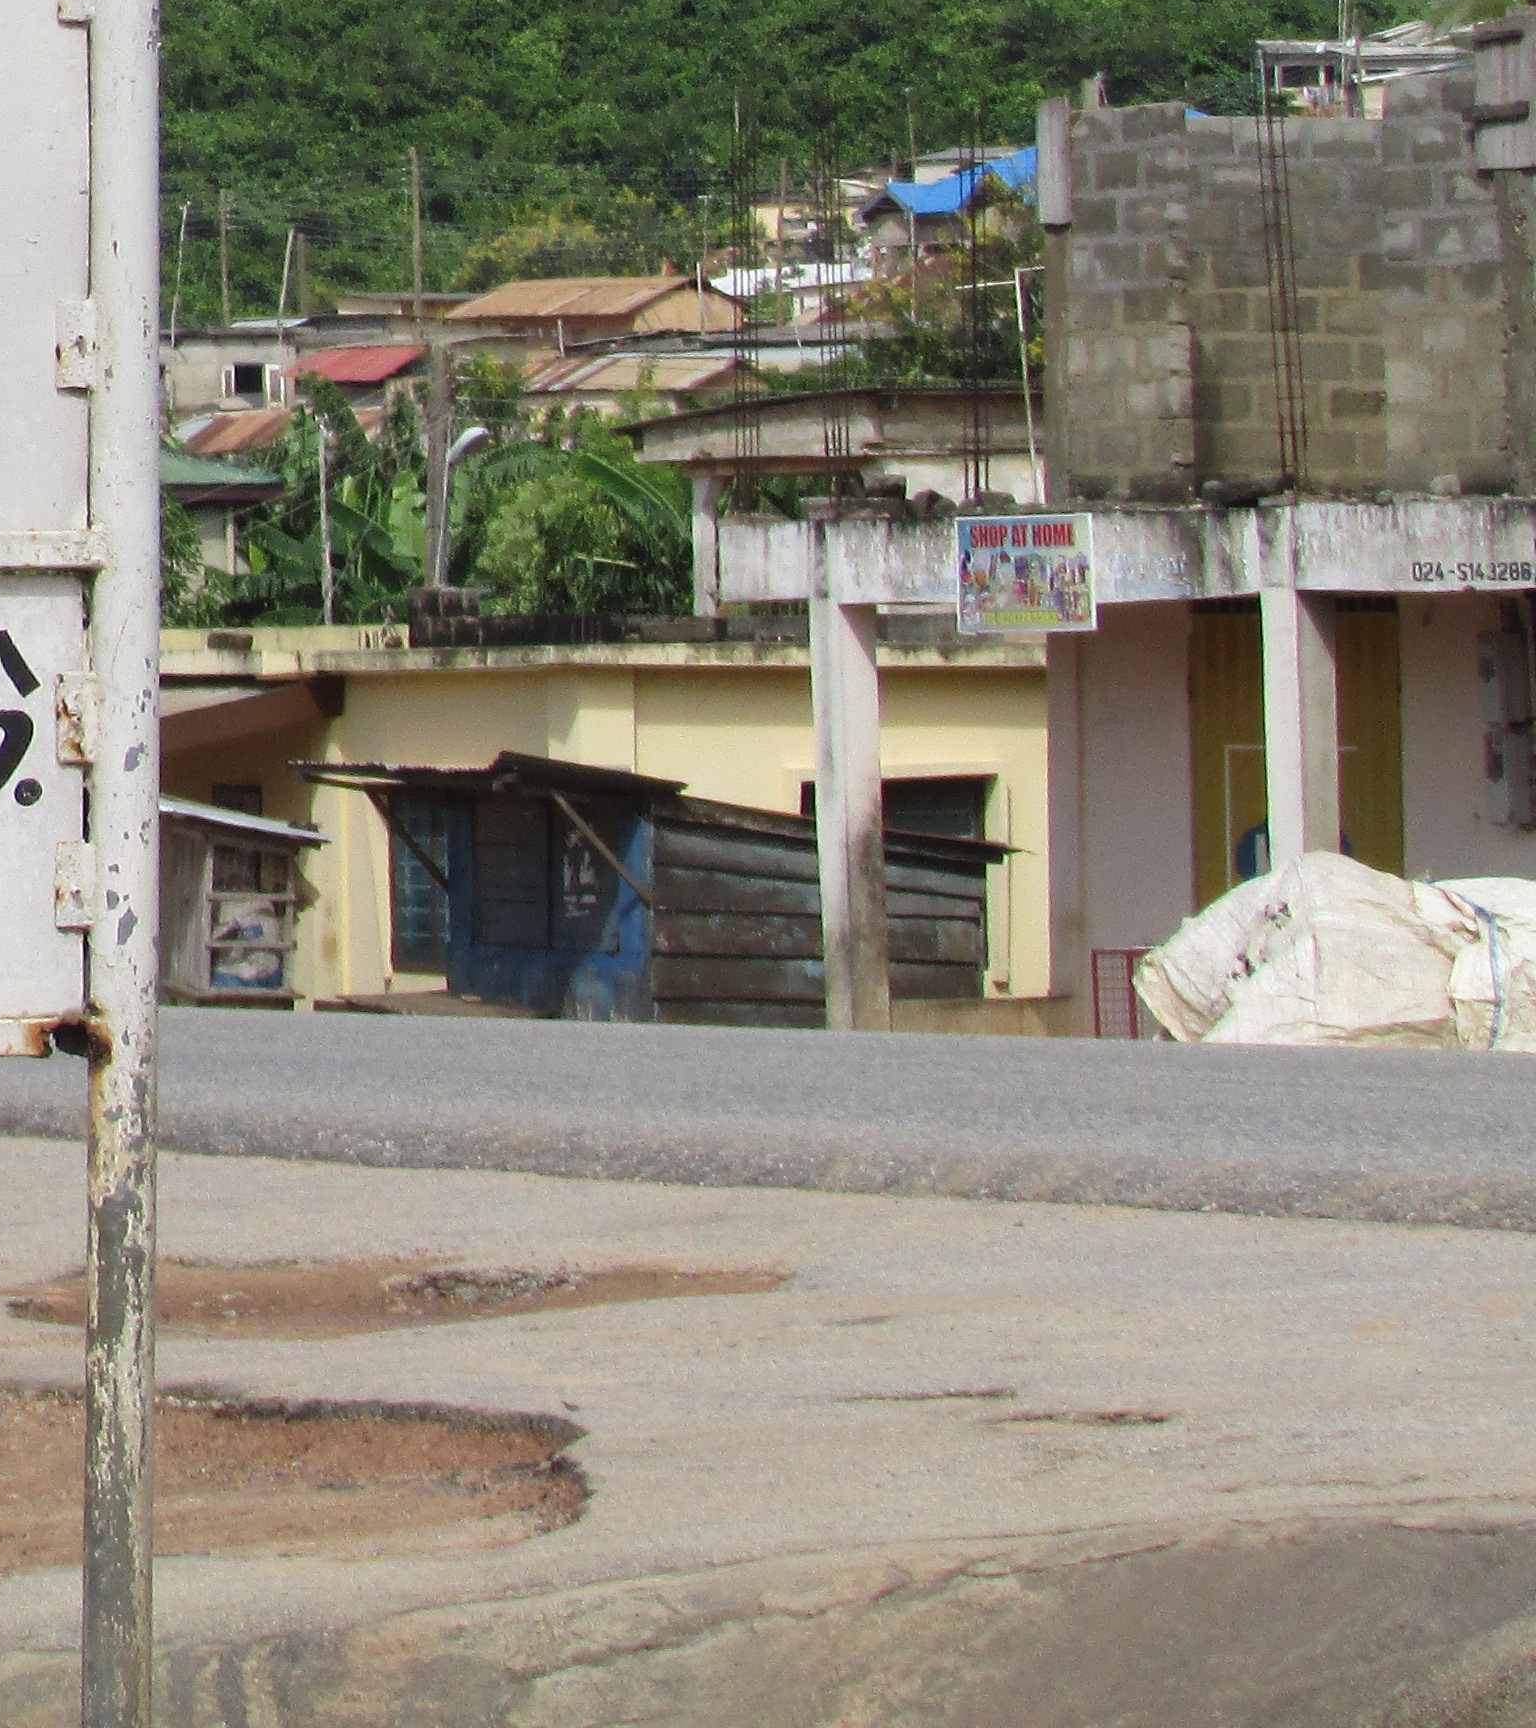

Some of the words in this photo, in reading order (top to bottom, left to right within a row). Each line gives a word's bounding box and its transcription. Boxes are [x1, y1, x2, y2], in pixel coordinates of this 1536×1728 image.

[970, 524, 1007, 548] SHOP
[1012, 523, 1028, 547] AT
[1032, 522, 1074, 547] HOME
